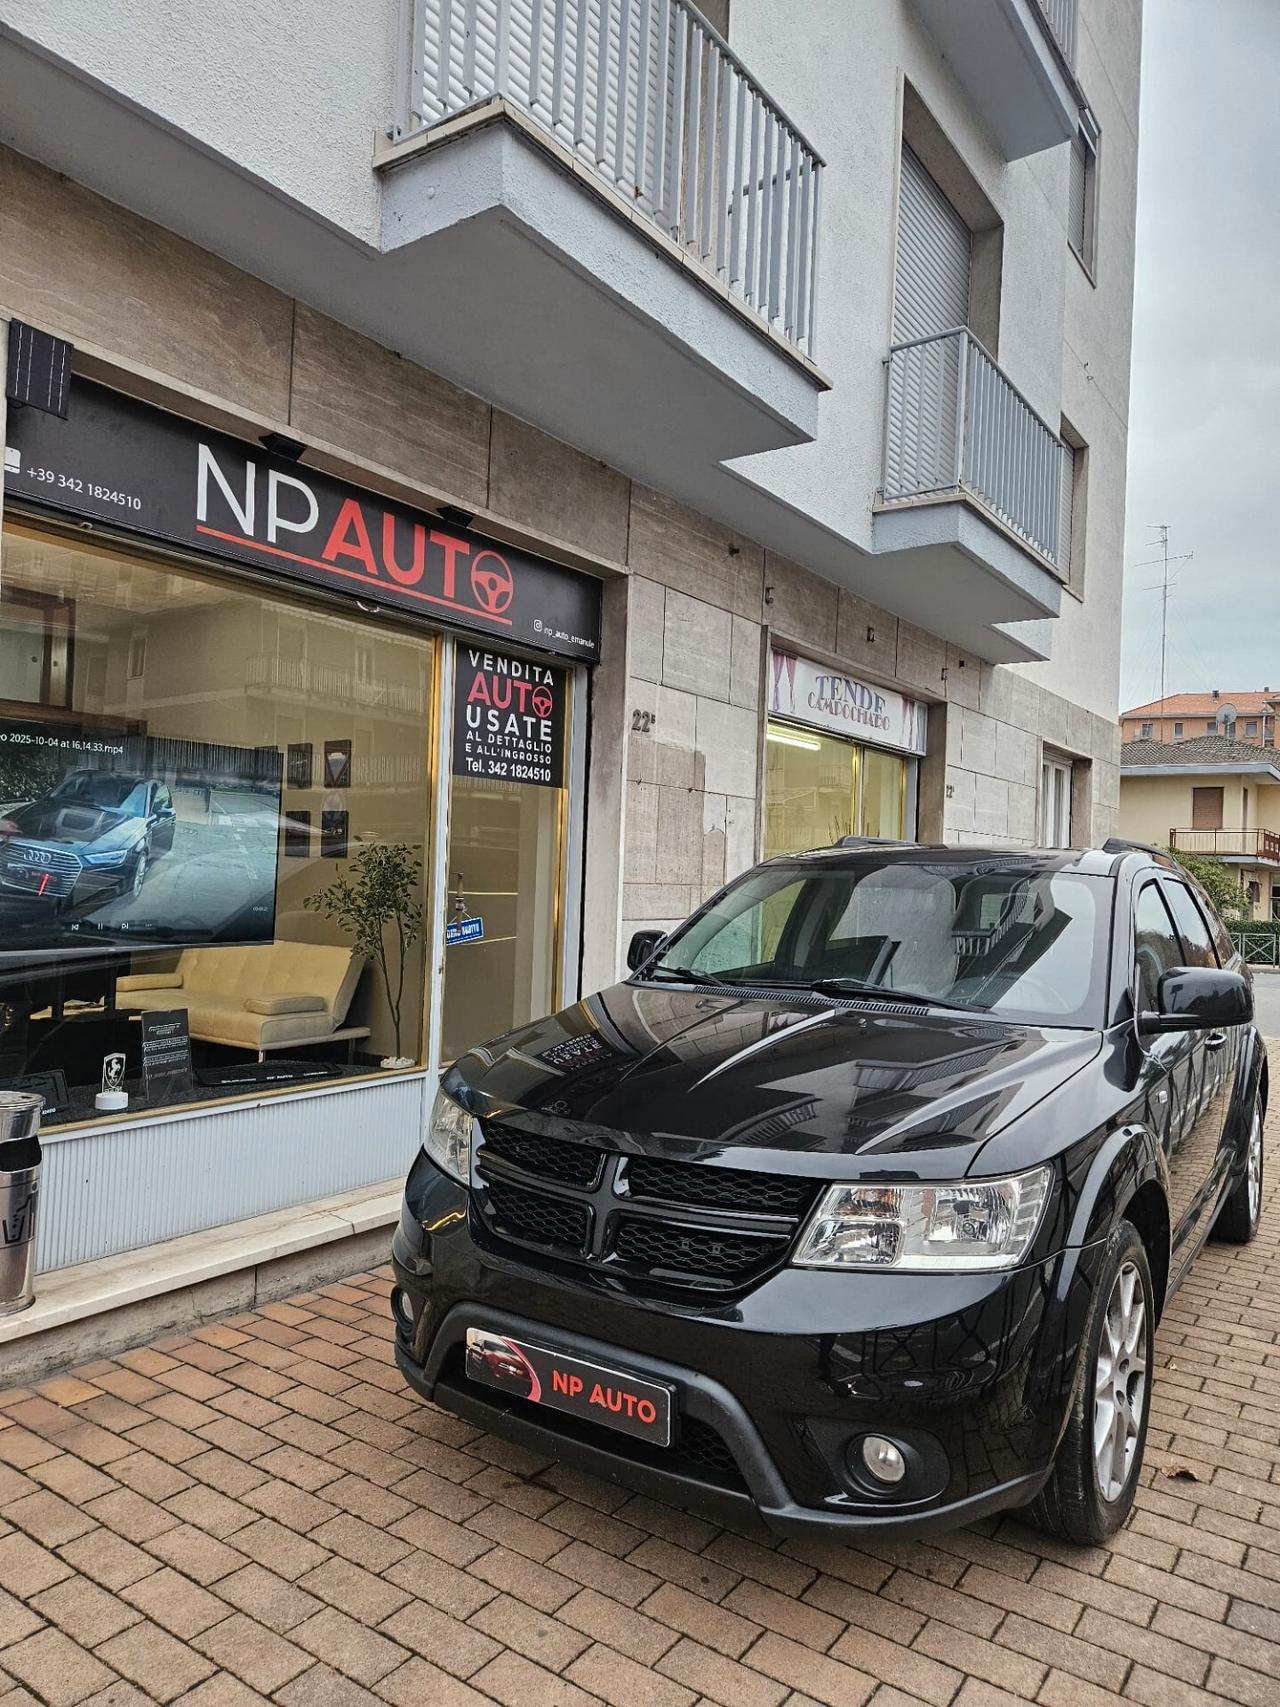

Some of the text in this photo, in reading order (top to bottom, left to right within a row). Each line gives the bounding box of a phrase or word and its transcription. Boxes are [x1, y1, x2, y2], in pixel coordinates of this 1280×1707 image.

[27, 467, 141, 510] +39 342 1824510
[468, 649, 554, 686] VENDITA
[815, 675, 886, 714] TENDE
[10, 733, 59, 747] 2025-10-04
[60, 740, 70, 749] at
[466, 704, 552, 742] USATE
[466, 730, 552, 753] AL DETTAGLIO
[465, 743, 551, 764] E ALL'INGROSSO
[465, 757, 551, 782] Tel. 342 1824510
[552, 1369, 657, 1424] NP AUTO
